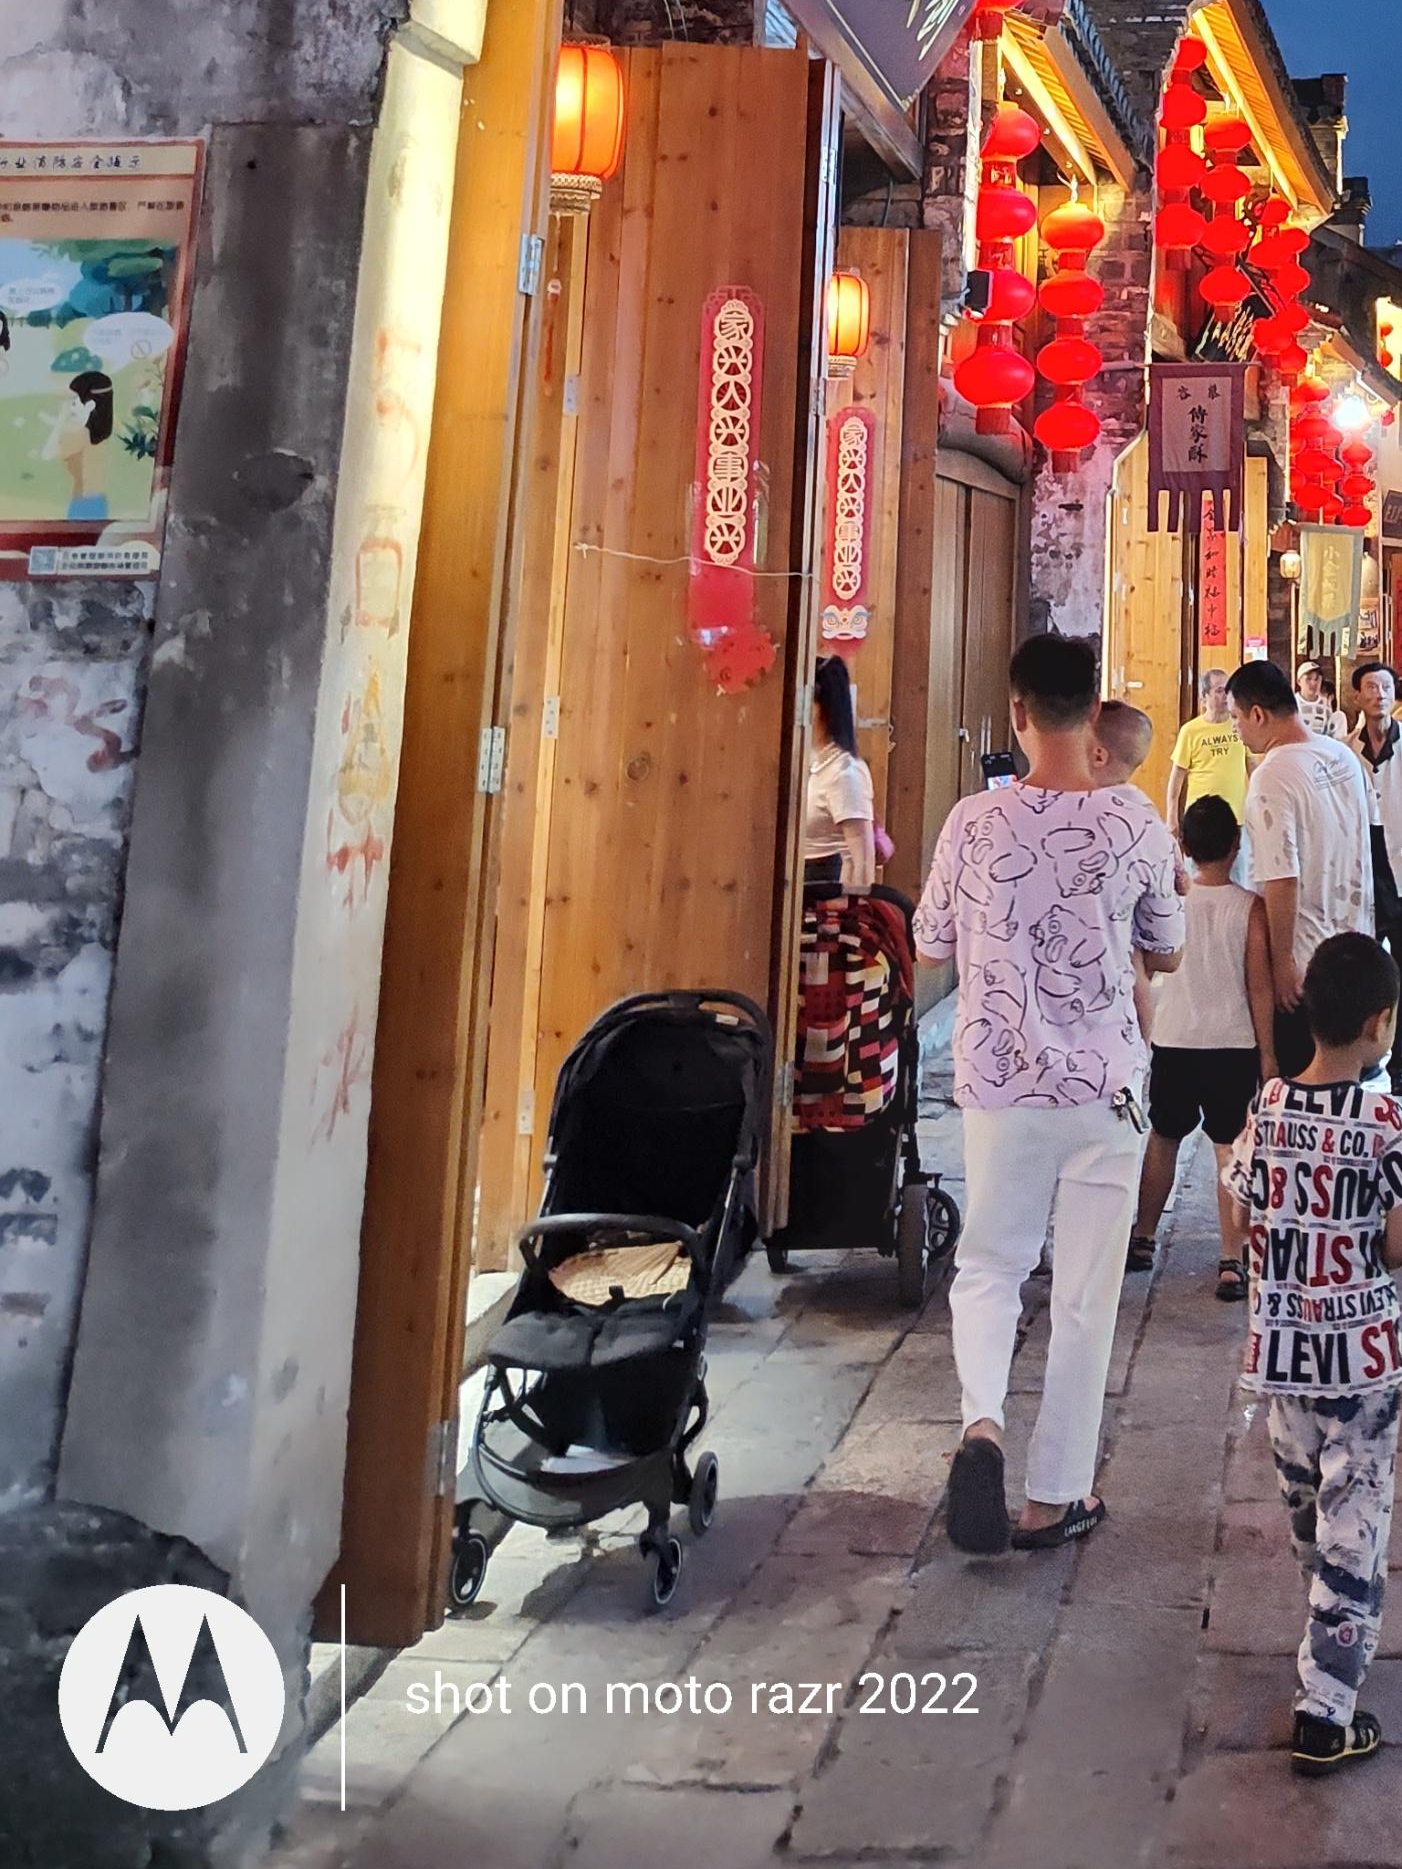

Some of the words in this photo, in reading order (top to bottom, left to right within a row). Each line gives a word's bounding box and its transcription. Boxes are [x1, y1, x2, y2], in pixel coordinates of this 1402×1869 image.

[1201, 733, 1239, 747] ALWAYS
[1210, 747, 1229, 757] TRY
[1321, 1127, 1336, 1154] &
[1265, 1329, 1353, 1385] LEVI
